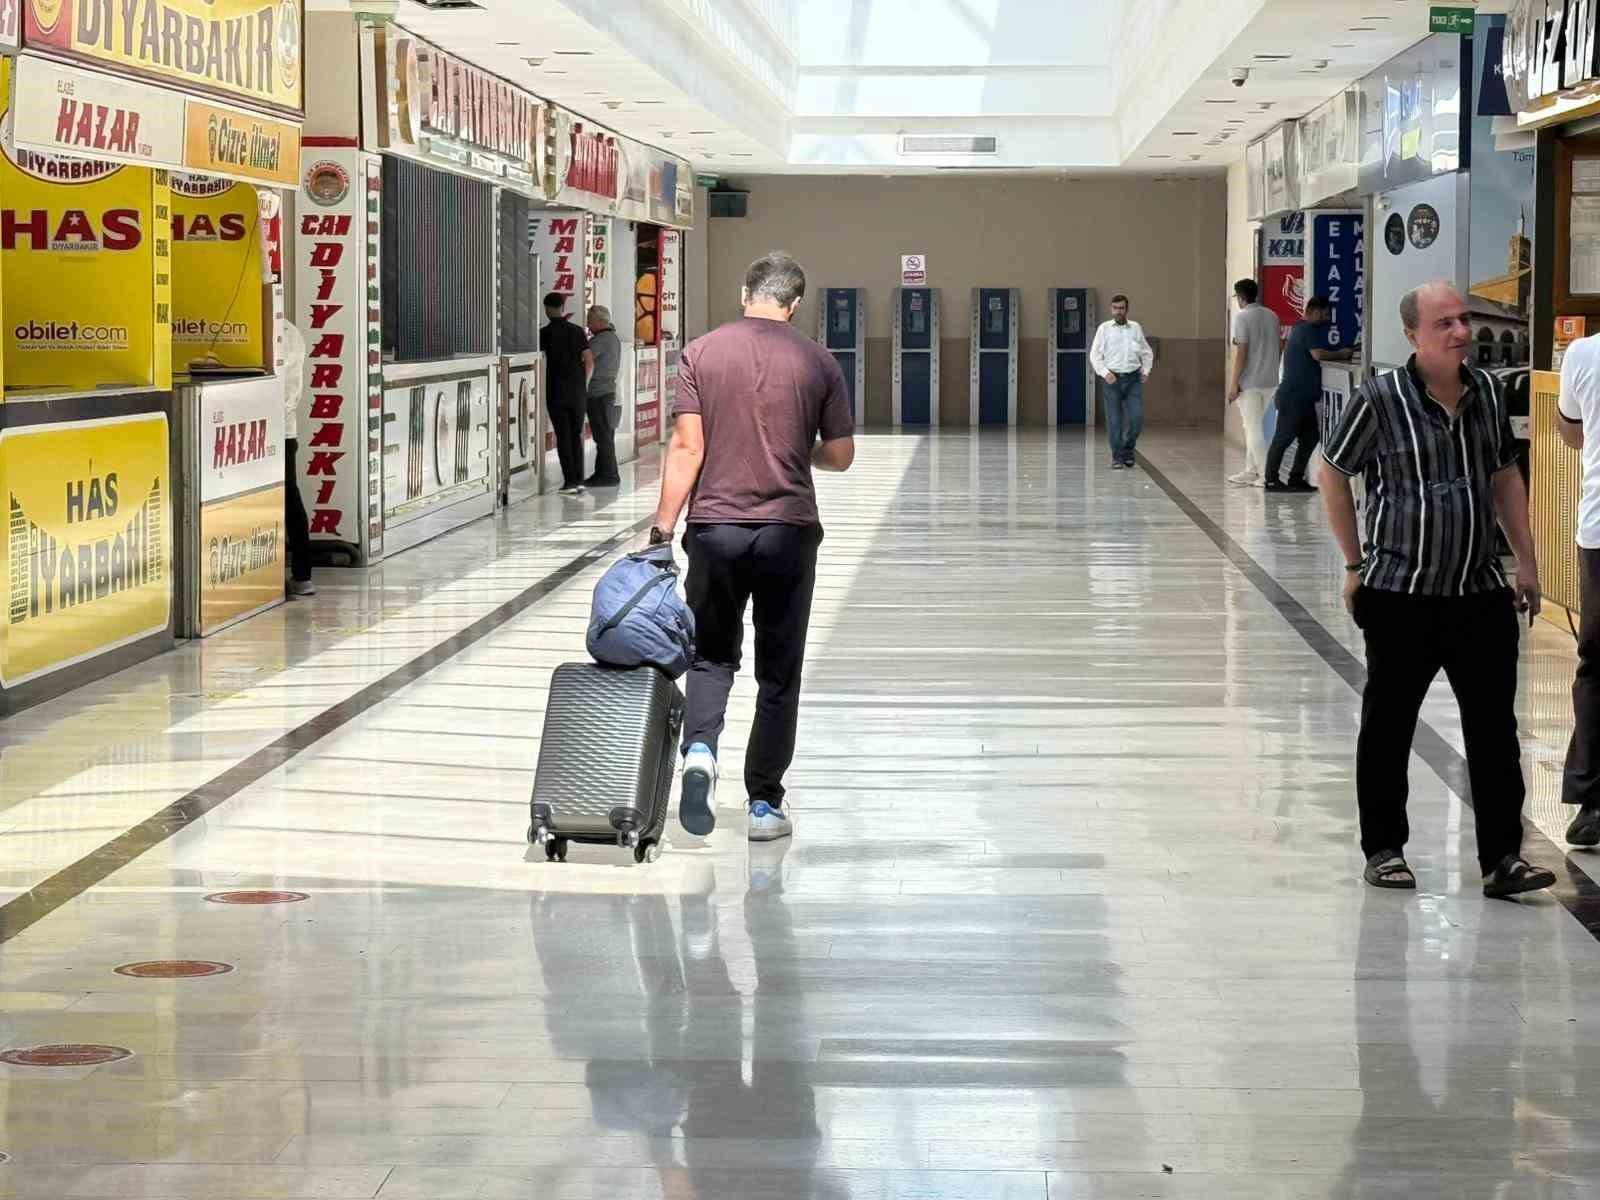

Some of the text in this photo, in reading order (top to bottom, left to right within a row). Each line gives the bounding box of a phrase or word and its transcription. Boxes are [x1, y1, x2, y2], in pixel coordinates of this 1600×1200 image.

[55, 97, 140, 154] HAZAR
[1, 208, 142, 251] HAS
[15, 320, 127, 341] obilet.com
[171, 318, 248, 336] ilet.com
[213, 418, 267, 470] HAZAR
[66, 472, 119, 524] HAS
